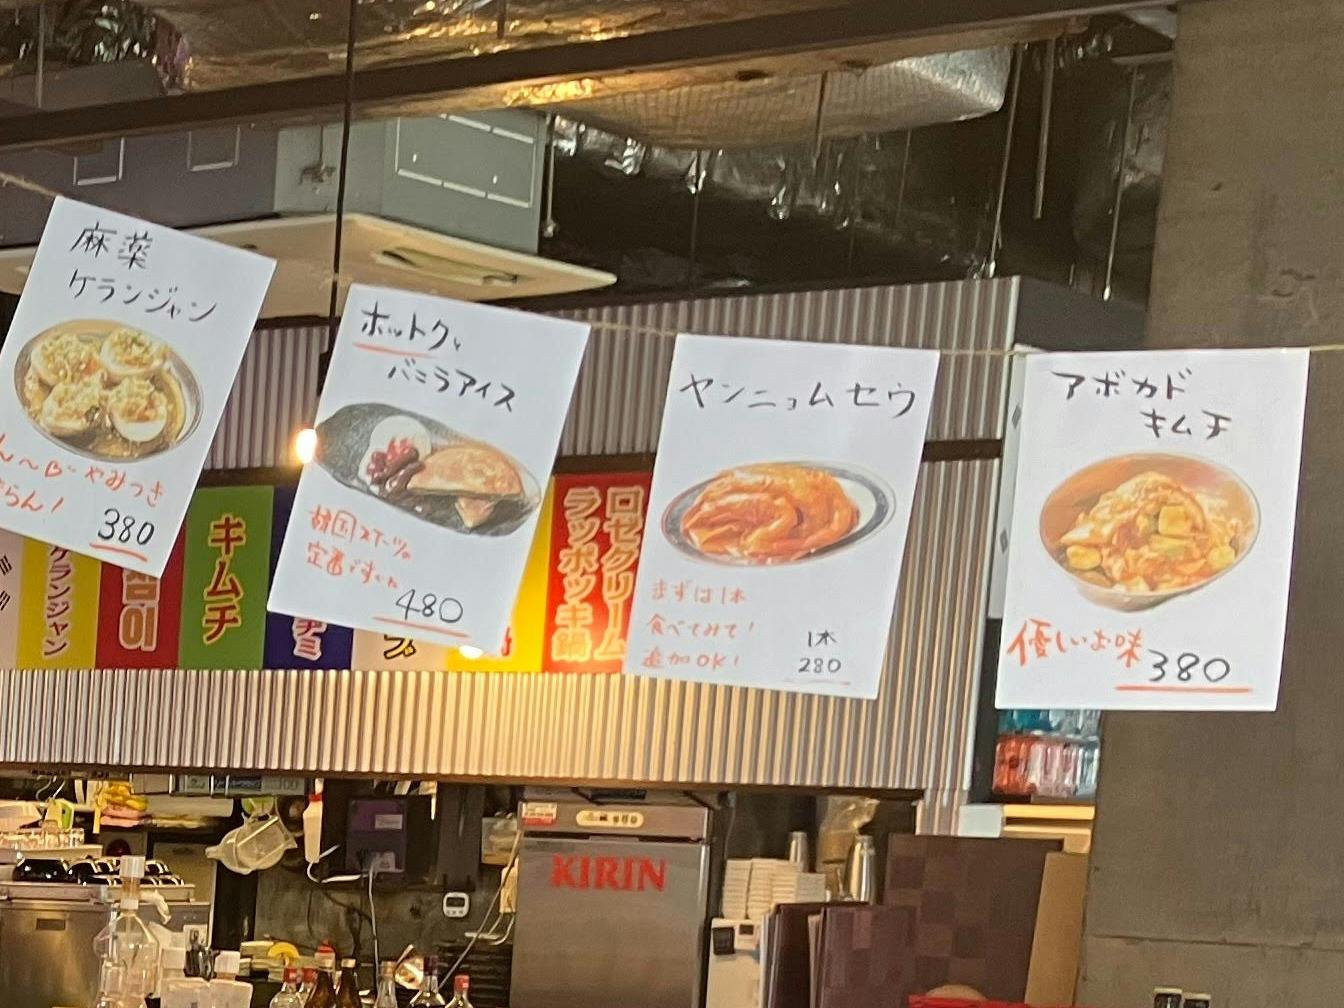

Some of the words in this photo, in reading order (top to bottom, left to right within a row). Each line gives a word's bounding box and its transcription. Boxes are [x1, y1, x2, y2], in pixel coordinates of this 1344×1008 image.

[69, 220, 155, 272] 麻薬
[67, 272, 219, 325] ケランジャン
[387, 358, 516, 413] バニラアイス
[678, 371, 917, 420] ヤンニョムセウ
[1050, 368, 1192, 400] アボカド
[1140, 409, 1233, 442] キムチ
[96, 507, 156, 546] 380
[203, 513, 248, 646] キムチ
[395, 588, 464, 623] 480
[797, 657, 842, 674] 280
[1148, 648, 1232, 684] 380
[549, 853, 668, 892] KIRIN
